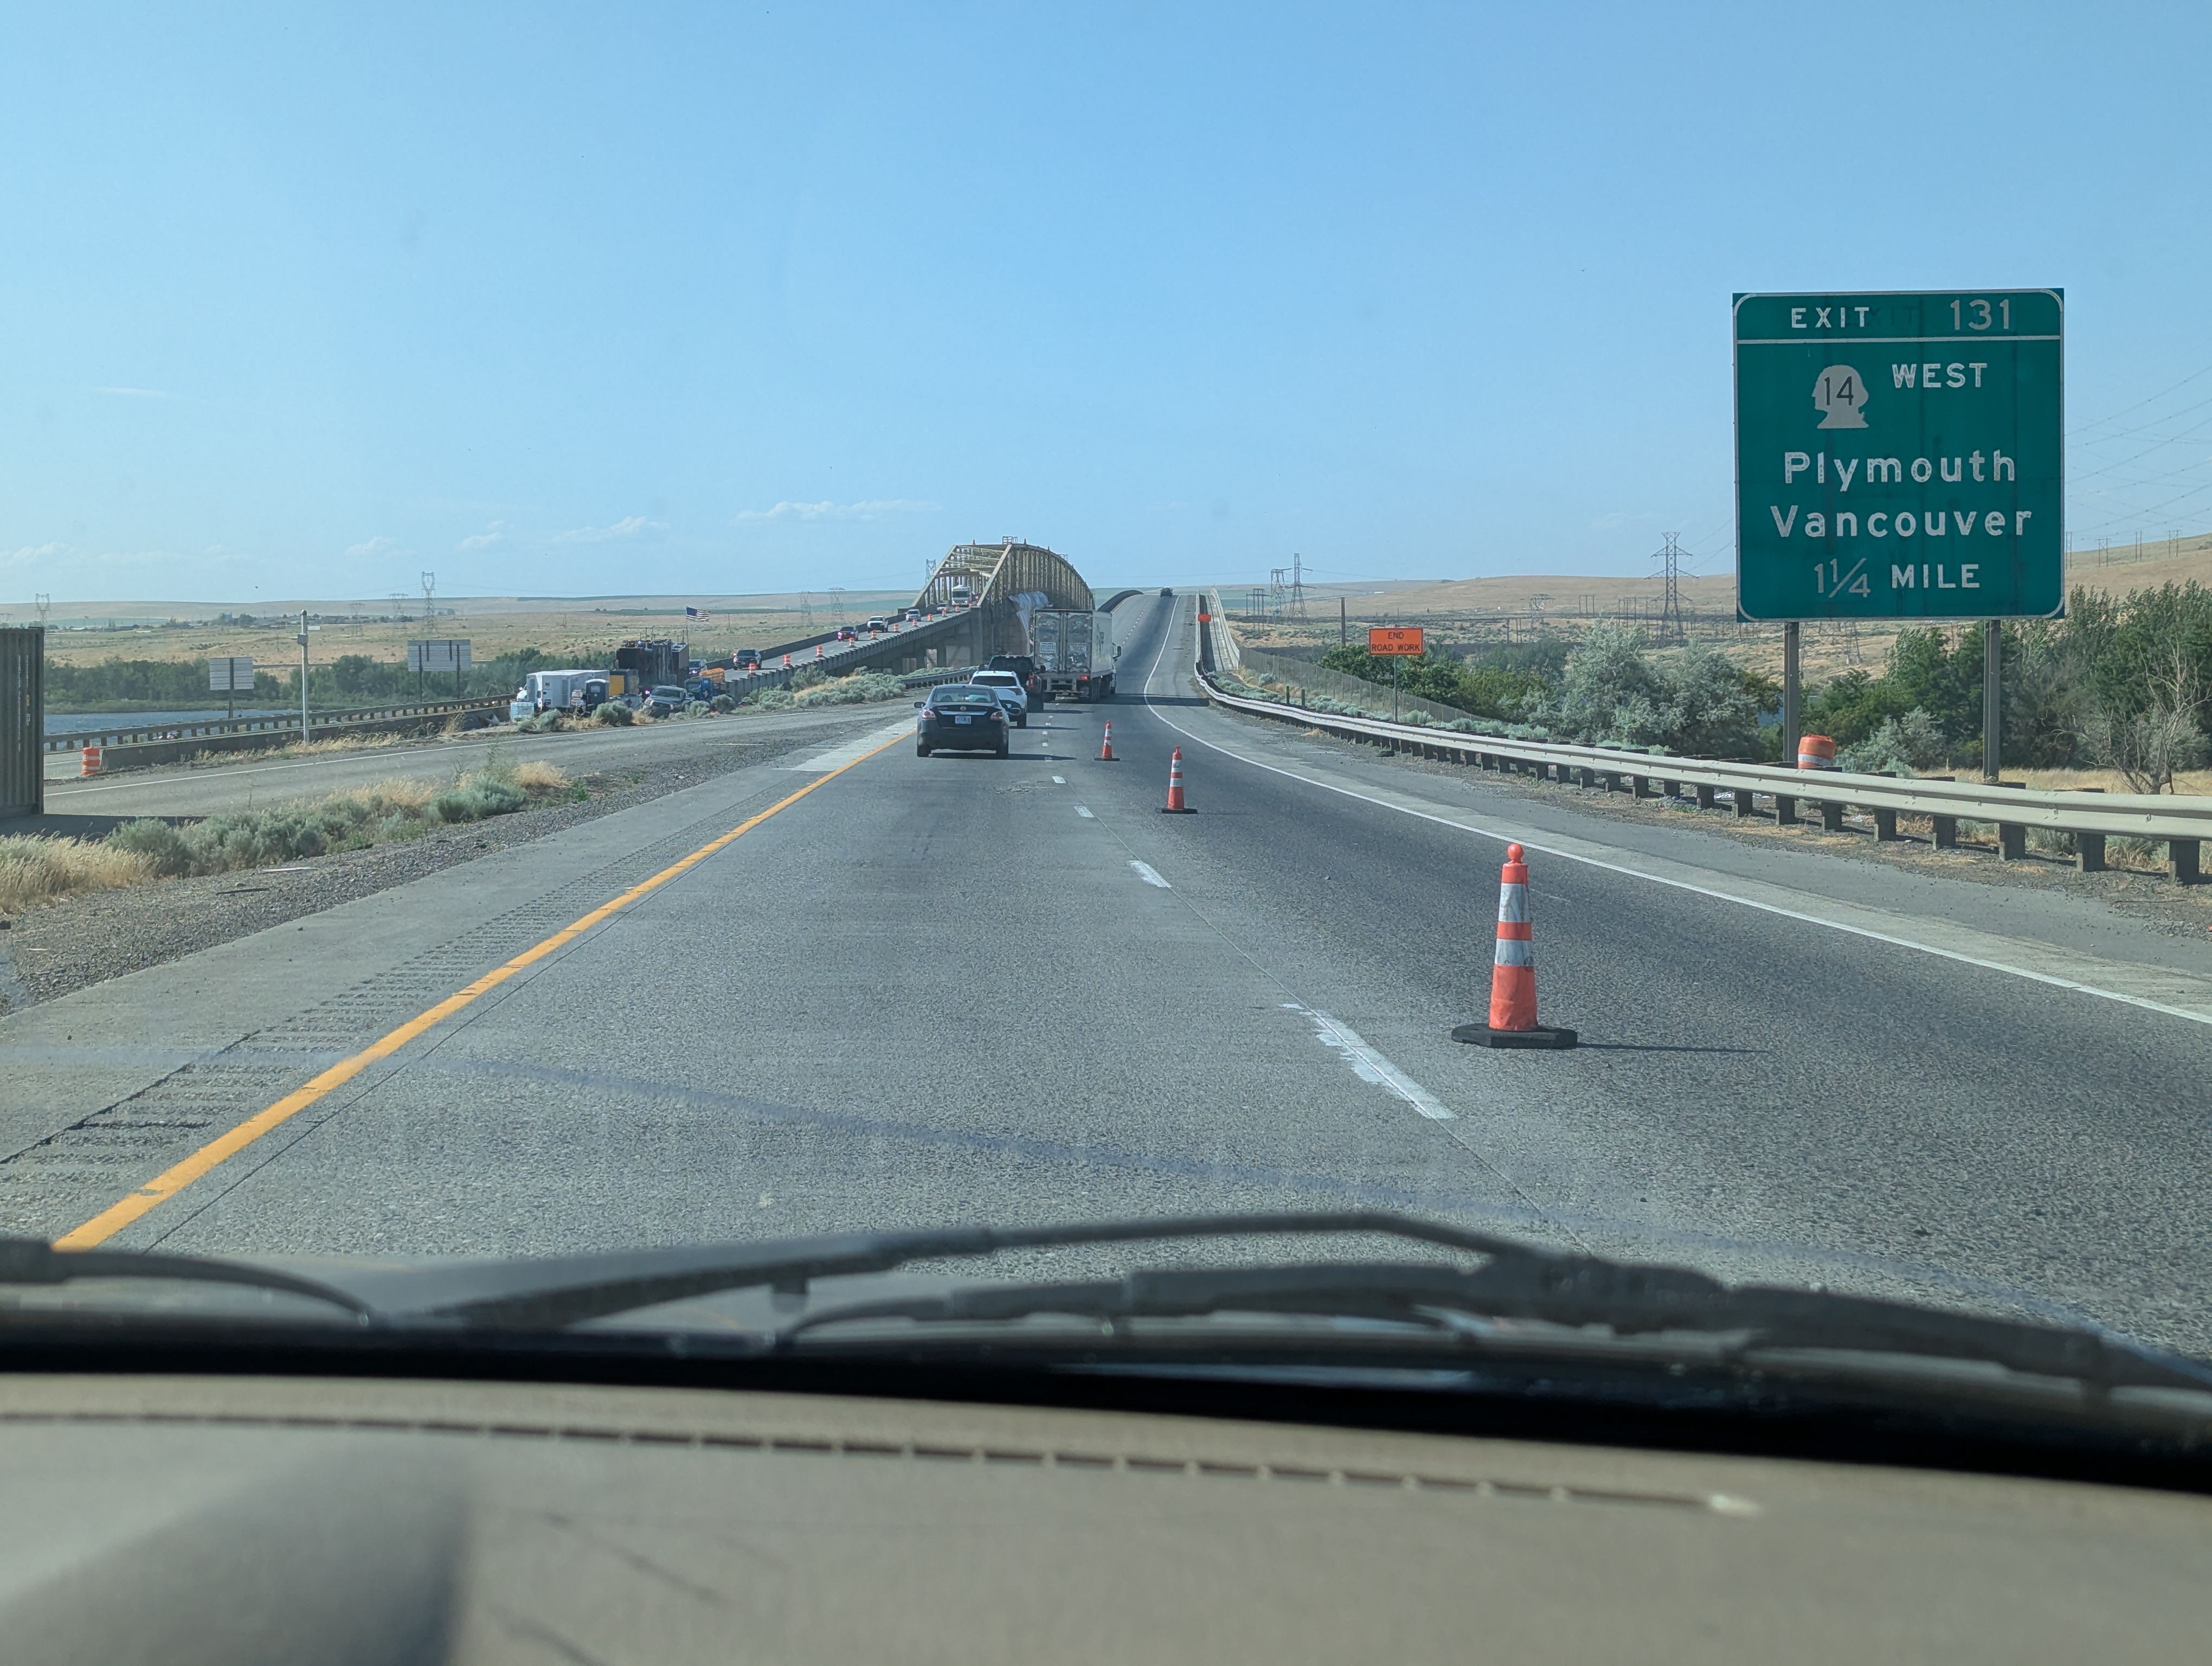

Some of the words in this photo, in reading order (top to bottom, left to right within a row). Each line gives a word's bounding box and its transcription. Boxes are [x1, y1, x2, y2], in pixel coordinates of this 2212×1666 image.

[1791, 306, 1869, 328] EXIT
[1950, 299, 2010, 330] 131
[1824, 376, 1854, 406] 14
[1892, 362, 1988, 388] WEST
[1784, 450, 2015, 492] Plymouth
[1770, 505, 2032, 537] Vancouver
[1892, 563, 1980, 588] MILE
